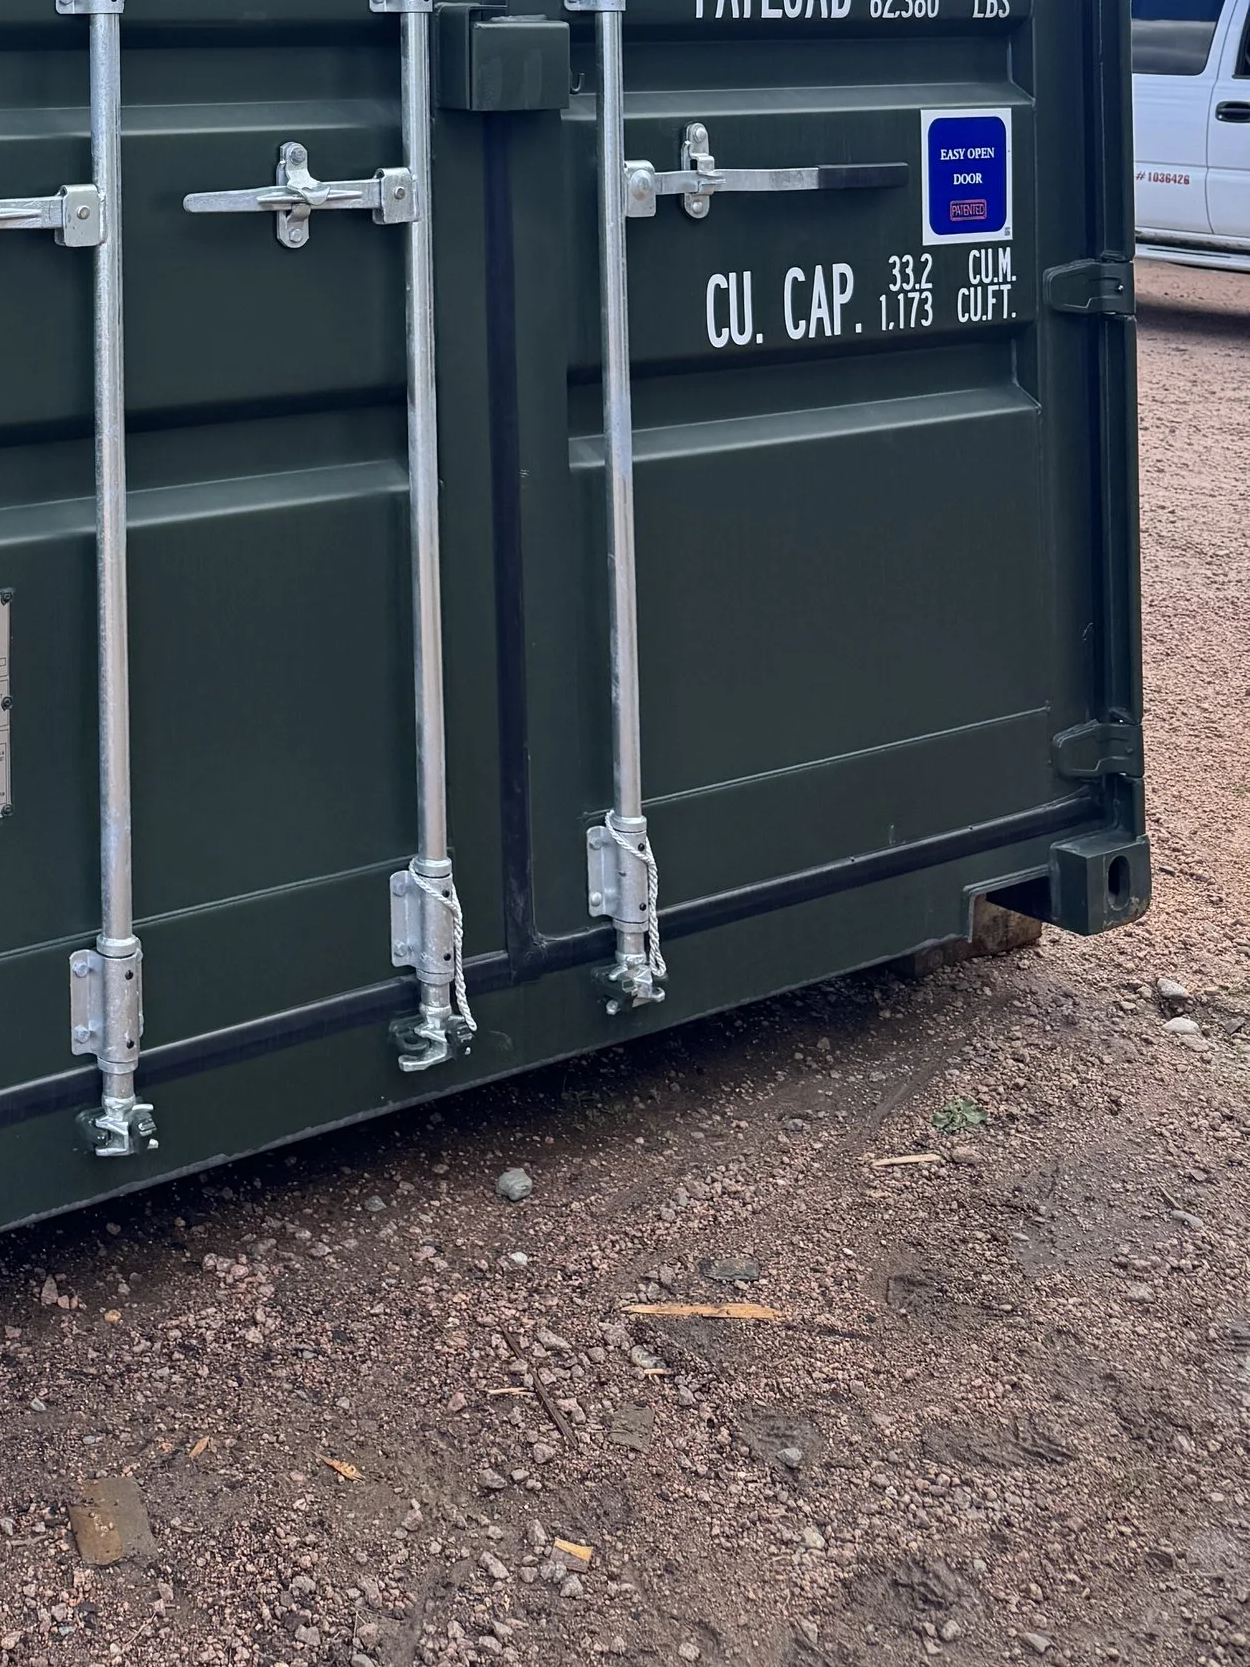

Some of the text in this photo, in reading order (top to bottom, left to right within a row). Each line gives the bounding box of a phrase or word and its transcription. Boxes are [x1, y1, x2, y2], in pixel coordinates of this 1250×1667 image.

[940, 147, 995, 160] EASY OPEN
[953, 173, 983, 185] DOOR
[952, 203, 985, 217] PATENTED
[706, 247, 1017, 348] CU. CAP. 33.2 CU.M.
[879, 284, 1017, 331] 1,173 CU.FT.
